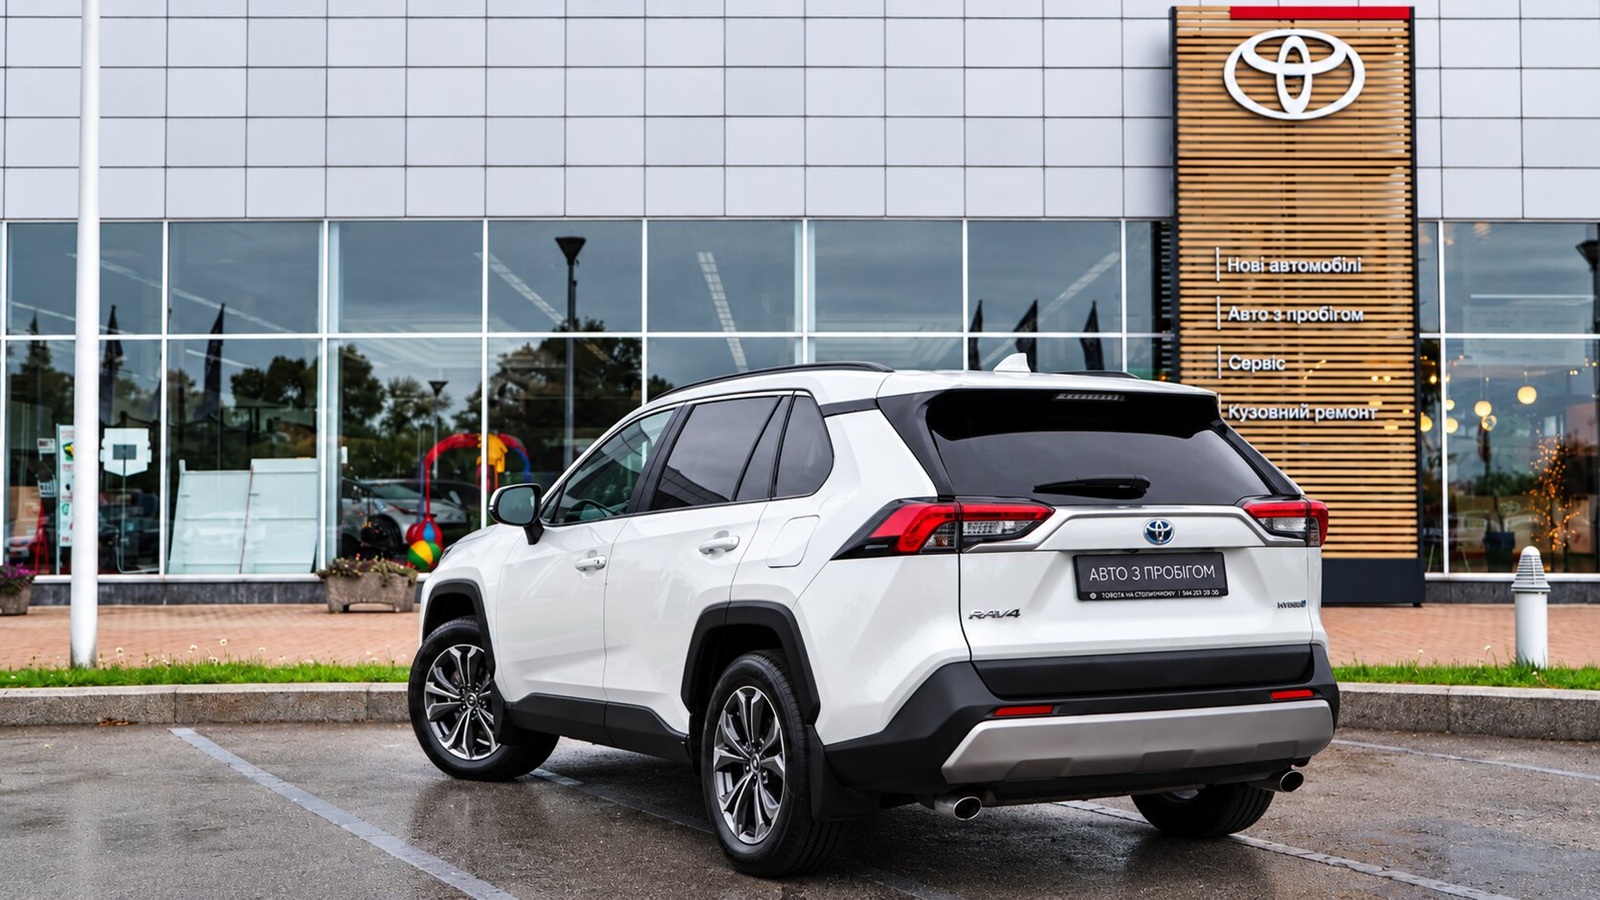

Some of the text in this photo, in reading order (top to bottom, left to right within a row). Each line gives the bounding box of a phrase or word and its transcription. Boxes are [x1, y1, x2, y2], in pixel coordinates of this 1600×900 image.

[1227, 256, 1362, 273] Нові автомобілі
[1228, 305, 1364, 324] Авто з пробігом
[1228, 354, 1286, 373] Сервіс
[1228, 403, 1378, 422] Кузовний ремонт
[1089, 566, 1128, 582] АВТО
[1144, 564, 1216, 580] ПРОБІГОМ
[968, 608, 1021, 620] RAV4
